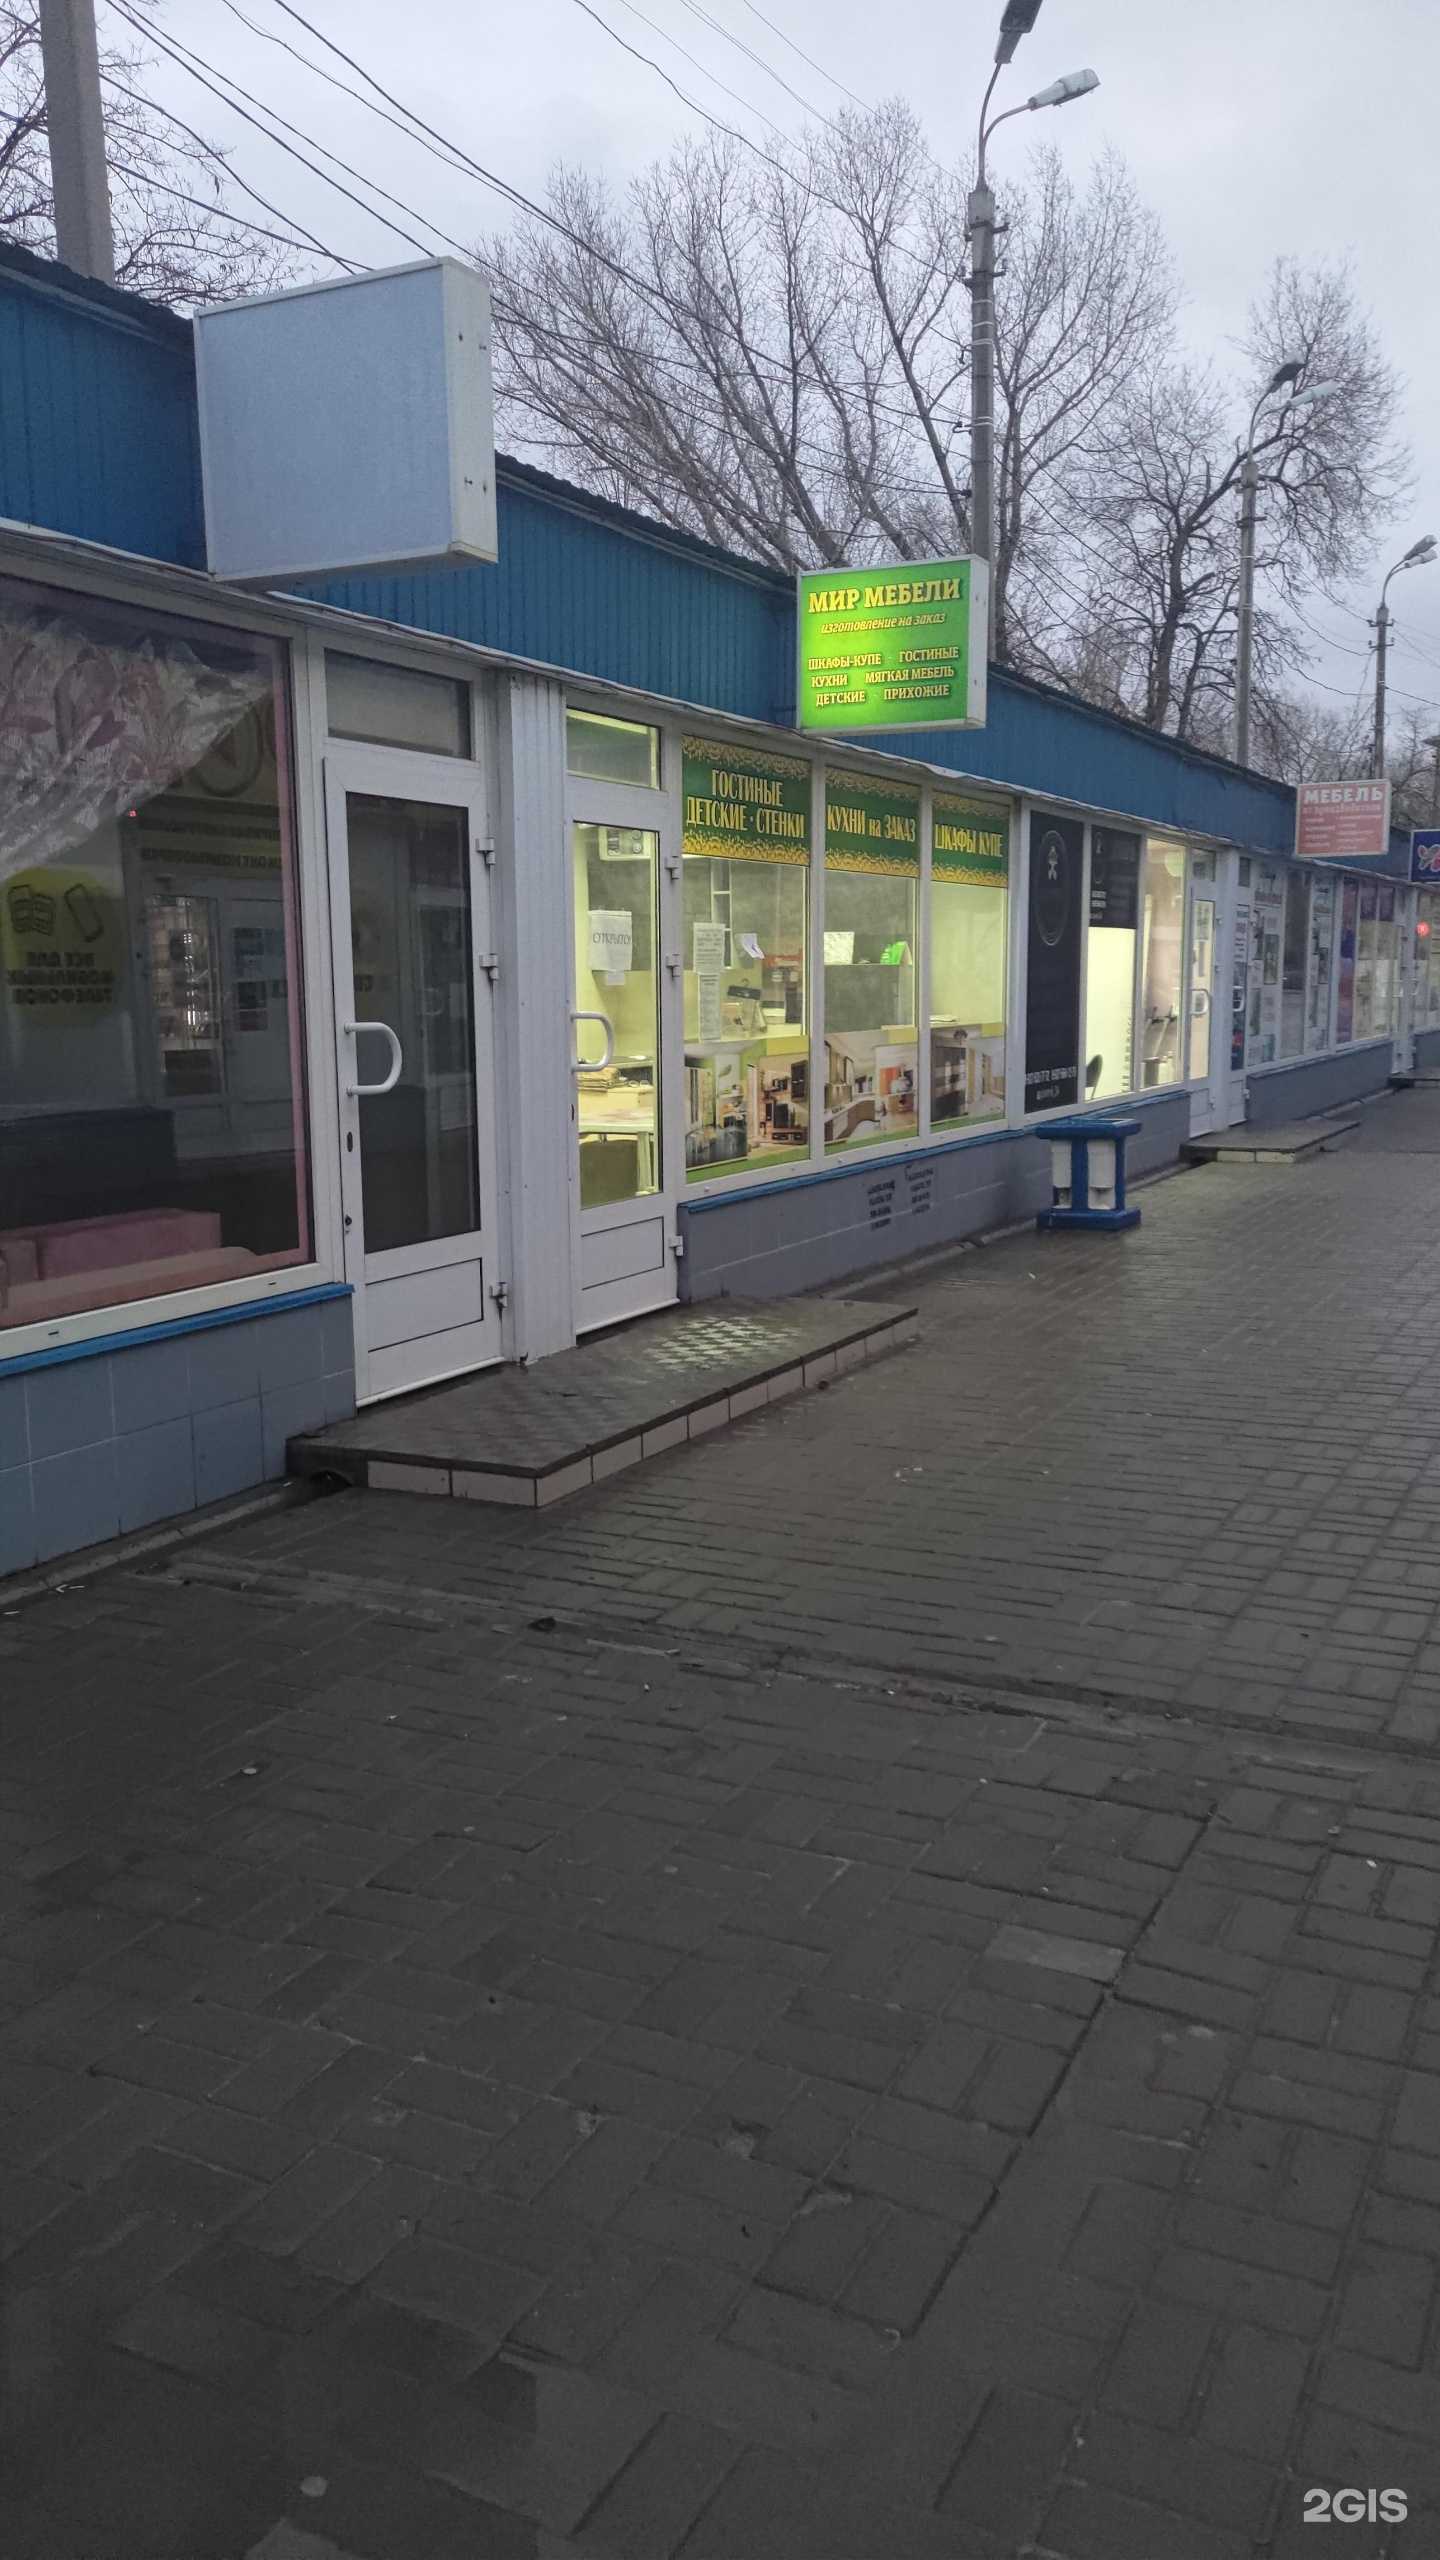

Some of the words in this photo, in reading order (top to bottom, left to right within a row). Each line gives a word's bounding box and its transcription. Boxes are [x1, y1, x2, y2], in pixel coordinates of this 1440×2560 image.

[808, 588, 860, 613] МИР
[864, 578, 961, 608] МЕБЕЛИ
[820, 618, 897, 634] изготовление
[898, 616, 912, 626] на
[914, 613, 946, 626] заказ
[808, 653, 881, 670] ШКАФЫ-КУПЕ
[899, 646, 959, 663] ГОСТИНЫЕ
[811, 674, 848, 688] КУХНИ
[865, 668, 910, 683] МЯГКАЯ
[911, 666, 955, 681] МЕБЕЛЬ
[816, 691, 866, 708] ДЕТСКИЕ
[884, 685, 950, 700] ПРИХОЖИЕ
[711, 769, 783, 807] ГОСТИНЫЕ
[1303, 787, 1383, 804] МЕБЕЛЬ
[686, 796, 748, 831] ДЕТСКИЕ
[756, 807, 806, 839] СТЕНКИ
[827, 804, 866, 833] КУХНИ
[868, 818, 881, 837] на
[884, 814, 916, 842] ЗАКАЗ
[935, 823, 976, 854] ШКАФЫ
[978, 831, 1003, 858] КУПЕ
